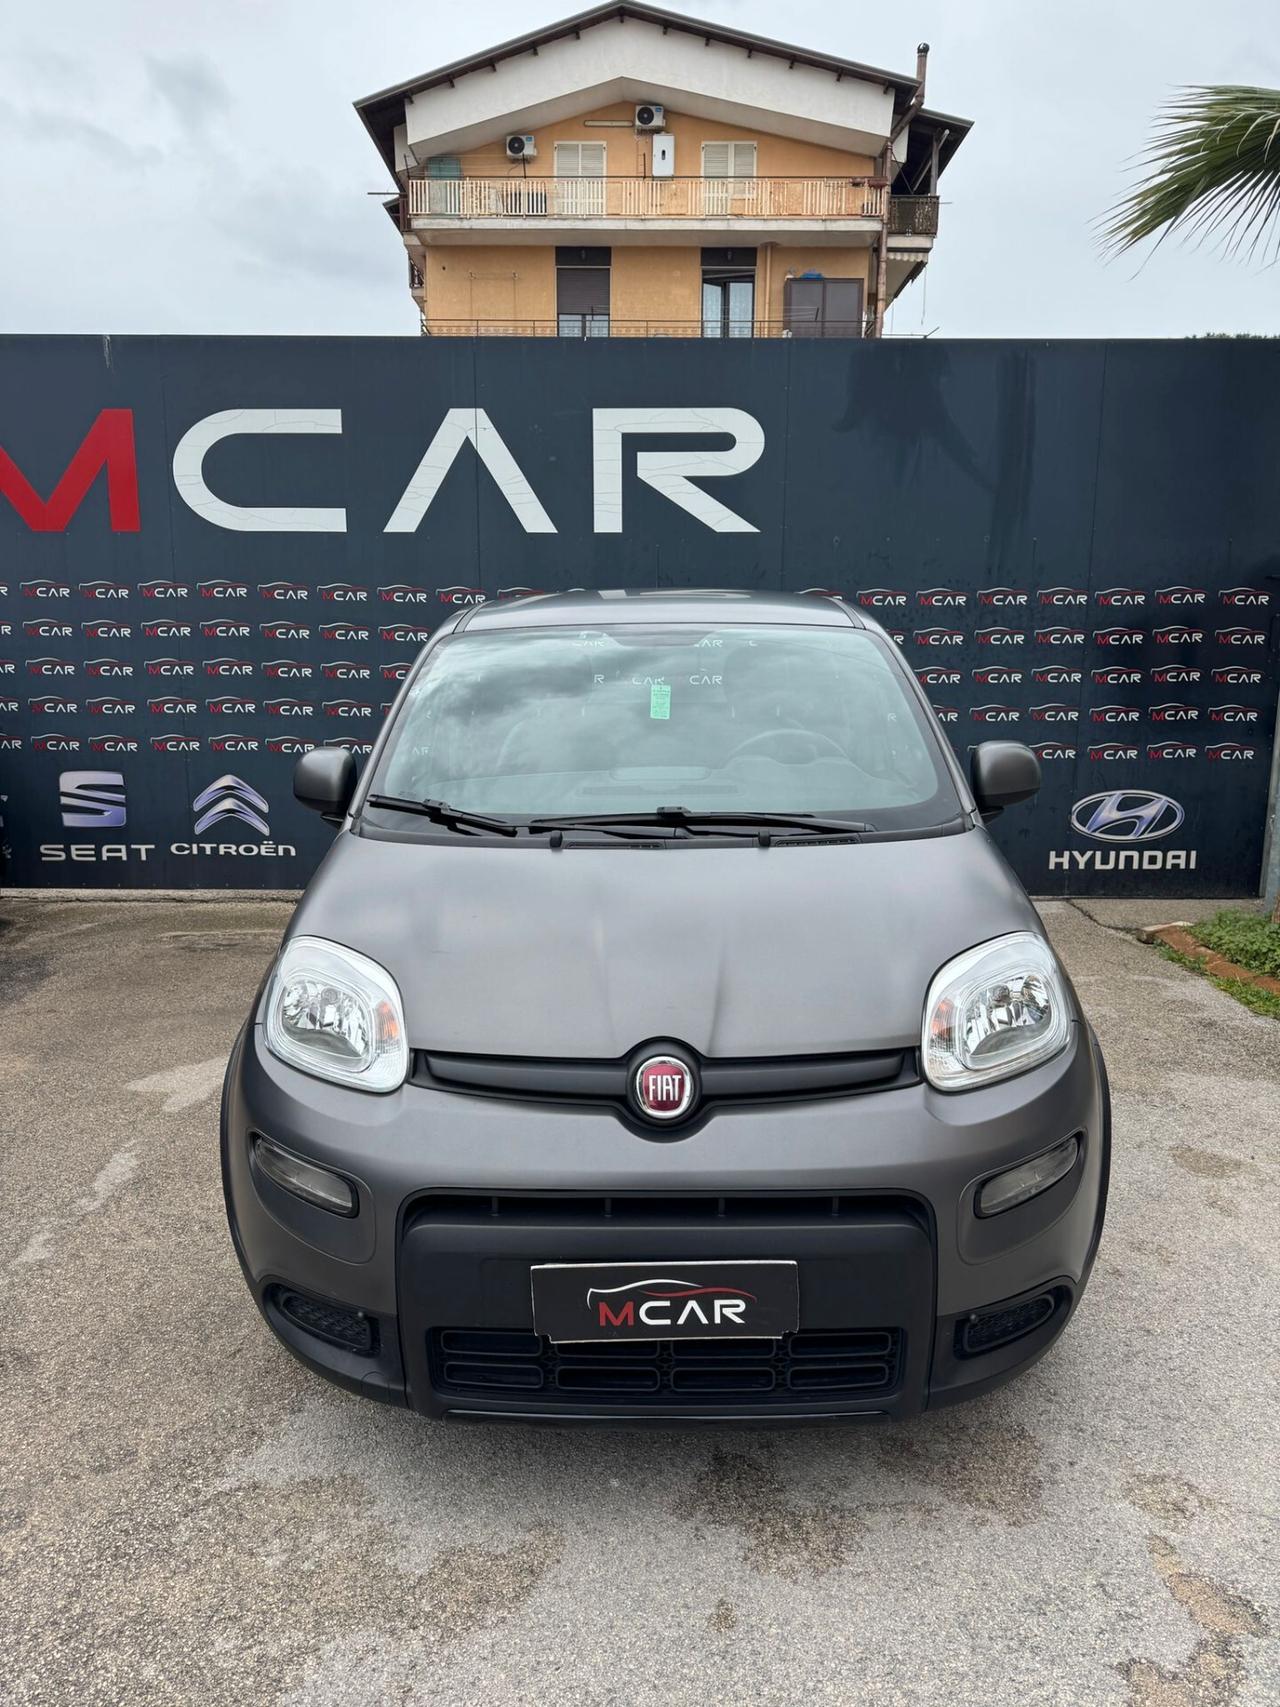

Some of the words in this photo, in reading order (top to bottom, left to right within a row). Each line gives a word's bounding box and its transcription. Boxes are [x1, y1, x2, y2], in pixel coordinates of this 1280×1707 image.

[0, 407, 766, 534] MCAR
[24, 587, 71, 598] MCAR
[84, 588, 129, 599] MCAR
[142, 587, 188, 598] MCAR
[200, 587, 248, 598] MCAR
[262, 589, 309, 600] MCAR
[321, 590, 368, 602] MCAR
[380, 592, 427, 603] MCAR
[440, 593, 486, 605] MCAR
[859, 595, 907, 606] MCAR
[919, 595, 967, 606] MCAR
[981, 594, 1028, 605] MCAR
[1041, 594, 1088, 605] MCAR
[1098, 594, 1146, 606] MCAR
[1158, 593, 1206, 604] MCAR
[1224, 595, 1270, 605] MCAR
[28, 626, 73, 637] MCAR
[85, 627, 131, 638] MCAR
[144, 626, 191, 637] MCAR
[203, 626, 250, 637] MCAR
[264, 628, 310, 640] MCAR
[322, 630, 369, 641] MCAR
[382, 631, 428, 642] MCAR
[916, 634, 964, 645] MCAR
[978, 634, 1025, 645] MCAR
[1037, 634, 1085, 644] MCAR
[1096, 634, 1144, 645] MCAR
[1155, 632, 1203, 643] MCAR
[1219, 634, 1265, 645] MCAR
[31, 664, 75, 675] MCAR
[87, 666, 134, 677] MCAR
[147, 665, 194, 676] MCAR
[206, 665, 253, 675] MCAR
[265, 667, 313, 678] MCAR
[324, 668, 371, 679] MCAR
[383, 670, 406, 680] MC
[689, 674, 723, 685] CAR
[975, 673, 1023, 684] MCAR
[1035, 672, 1082, 683] MCAR
[1094, 673, 1142, 684] MCAR
[1153, 671, 1201, 682] MCAR
[1215, 673, 1262, 683] MCAR
[32, 703, 78, 713] MCAR
[90, 704, 136, 714] MCAR
[150, 703, 197, 714] MCAR
[209, 703, 256, 713] MCAR
[268, 705, 314, 716] MCAR
[327, 706, 372, 717] MCAR
[938, 712, 959, 722] AR
[973, 711, 1020, 722] MCAR
[1033, 711, 1079, 721] MCAR
[1092, 711, 1140, 722] MCAR
[1151, 710, 1199, 721] MCAR
[1211, 712, 1258, 722] MCAR
[0, 740, 22, 750] AR
[33, 740, 80, 751] MCAR
[91, 741, 138, 752] MCAR
[153, 741, 200, 751] MCAR
[211, 741, 259, 751] MCAR
[1089, 749, 1138, 760] MCAR
[1148, 748, 1197, 759] MCAR
[1208, 750, 1255, 760] MCAR
[39, 844, 155, 861] SEAT
[170, 841, 297, 857] CITROËN
[1048, 850, 1197, 870] HYUNDAI
[648, 1074, 682, 1102] FIAT
[599, 1299, 746, 1327] MCAR
